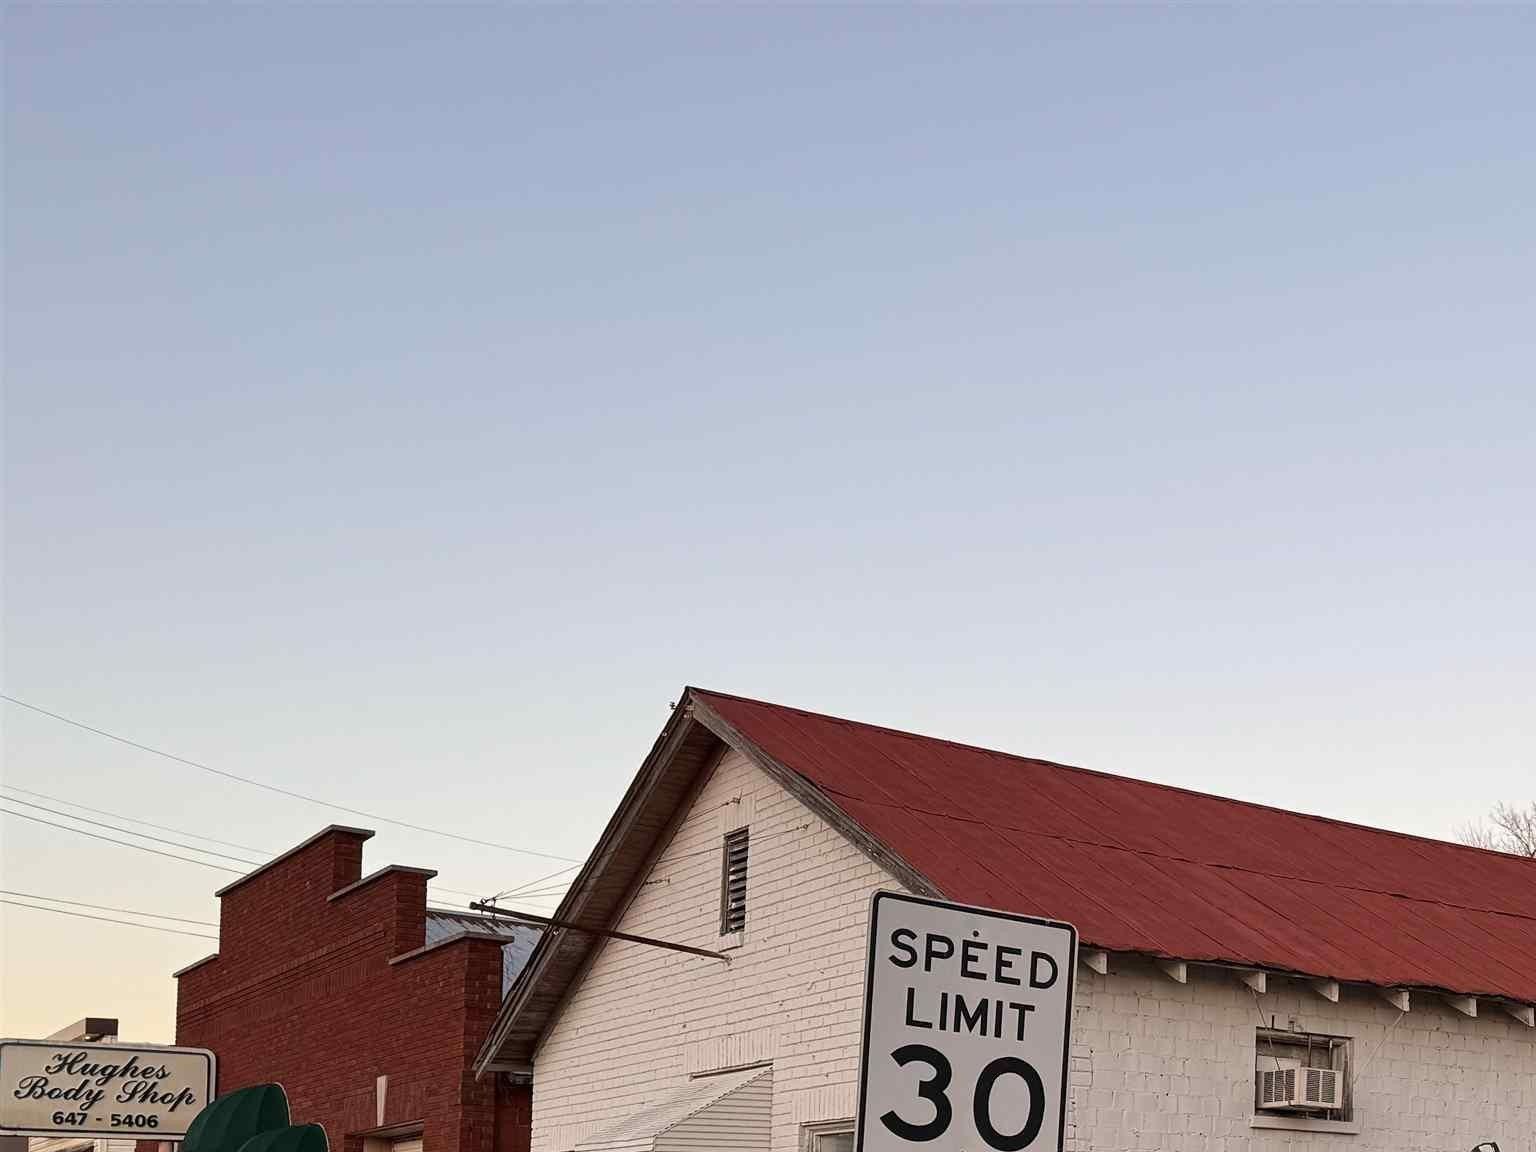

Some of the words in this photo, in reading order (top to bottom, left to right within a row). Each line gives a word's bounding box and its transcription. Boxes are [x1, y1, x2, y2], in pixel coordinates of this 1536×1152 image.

[888, 928, 1058, 989] SPEED
[905, 987, 1036, 1041] LIMIT
[45, 1052, 171, 1085] Hughes
[14, 1076, 104, 1111] Body
[117, 1080, 196, 1112] Shop
[880, 1044, 1046, 1152] 30
[52, 1112, 88, 1126] 647
[110, 1113, 158, 1128] 5406
